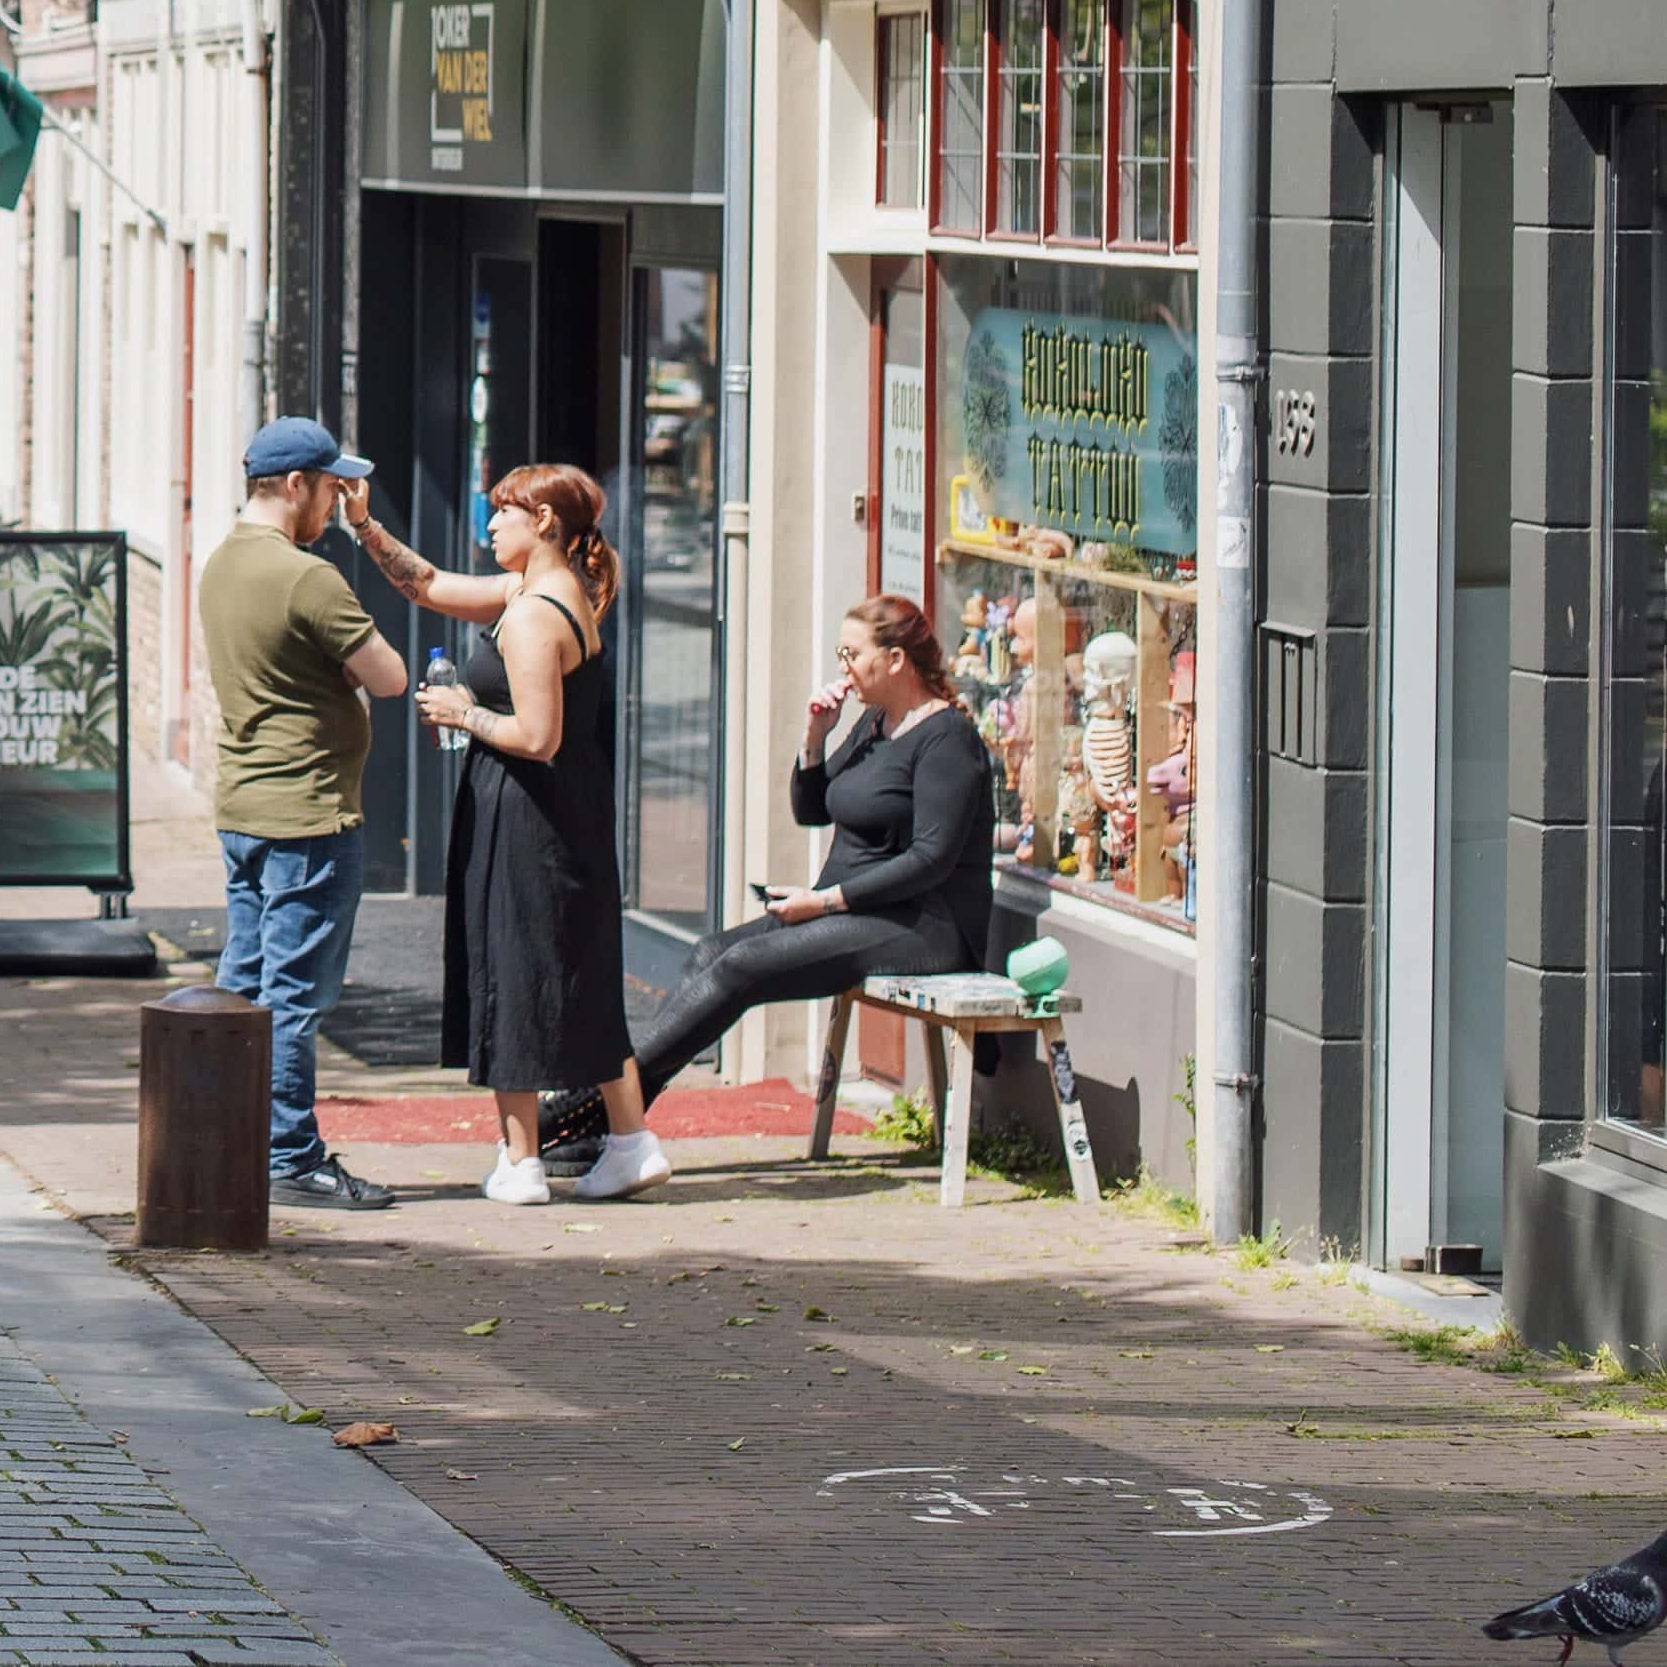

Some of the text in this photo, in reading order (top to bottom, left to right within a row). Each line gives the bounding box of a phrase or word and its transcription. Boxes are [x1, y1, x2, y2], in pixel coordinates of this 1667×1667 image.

[431, 4, 470, 50] JOKER
[436, 49, 488, 93] VAN DER
[462, 97, 492, 141] WIEL
[1028, 430, 1141, 541] TATTOO
[20, 690, 88, 714] ZIEN
